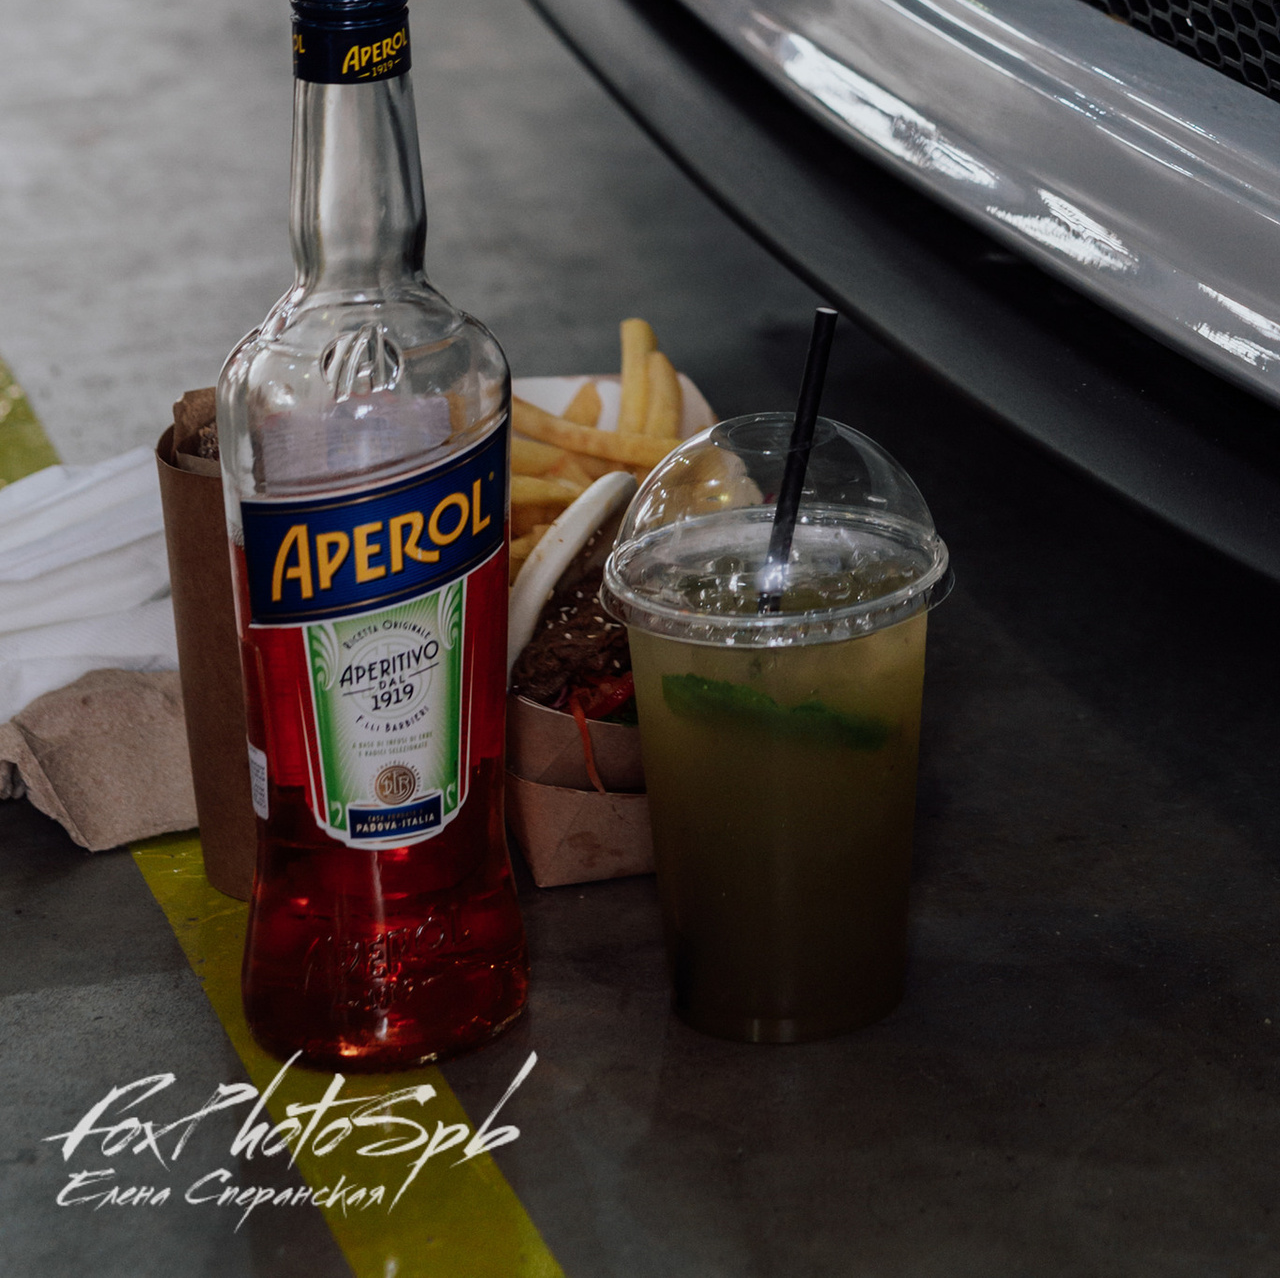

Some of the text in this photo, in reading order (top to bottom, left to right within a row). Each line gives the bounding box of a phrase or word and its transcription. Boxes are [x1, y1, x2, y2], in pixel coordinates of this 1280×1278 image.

[341, 27, 408, 75] APEROL
[371, 59, 394, 78] 1919
[271, 477, 492, 603] APEROL
[339, 640, 439, 688] APERITIVO
[379, 675, 406, 690] DAL
[371, 683, 414, 711] 1919
